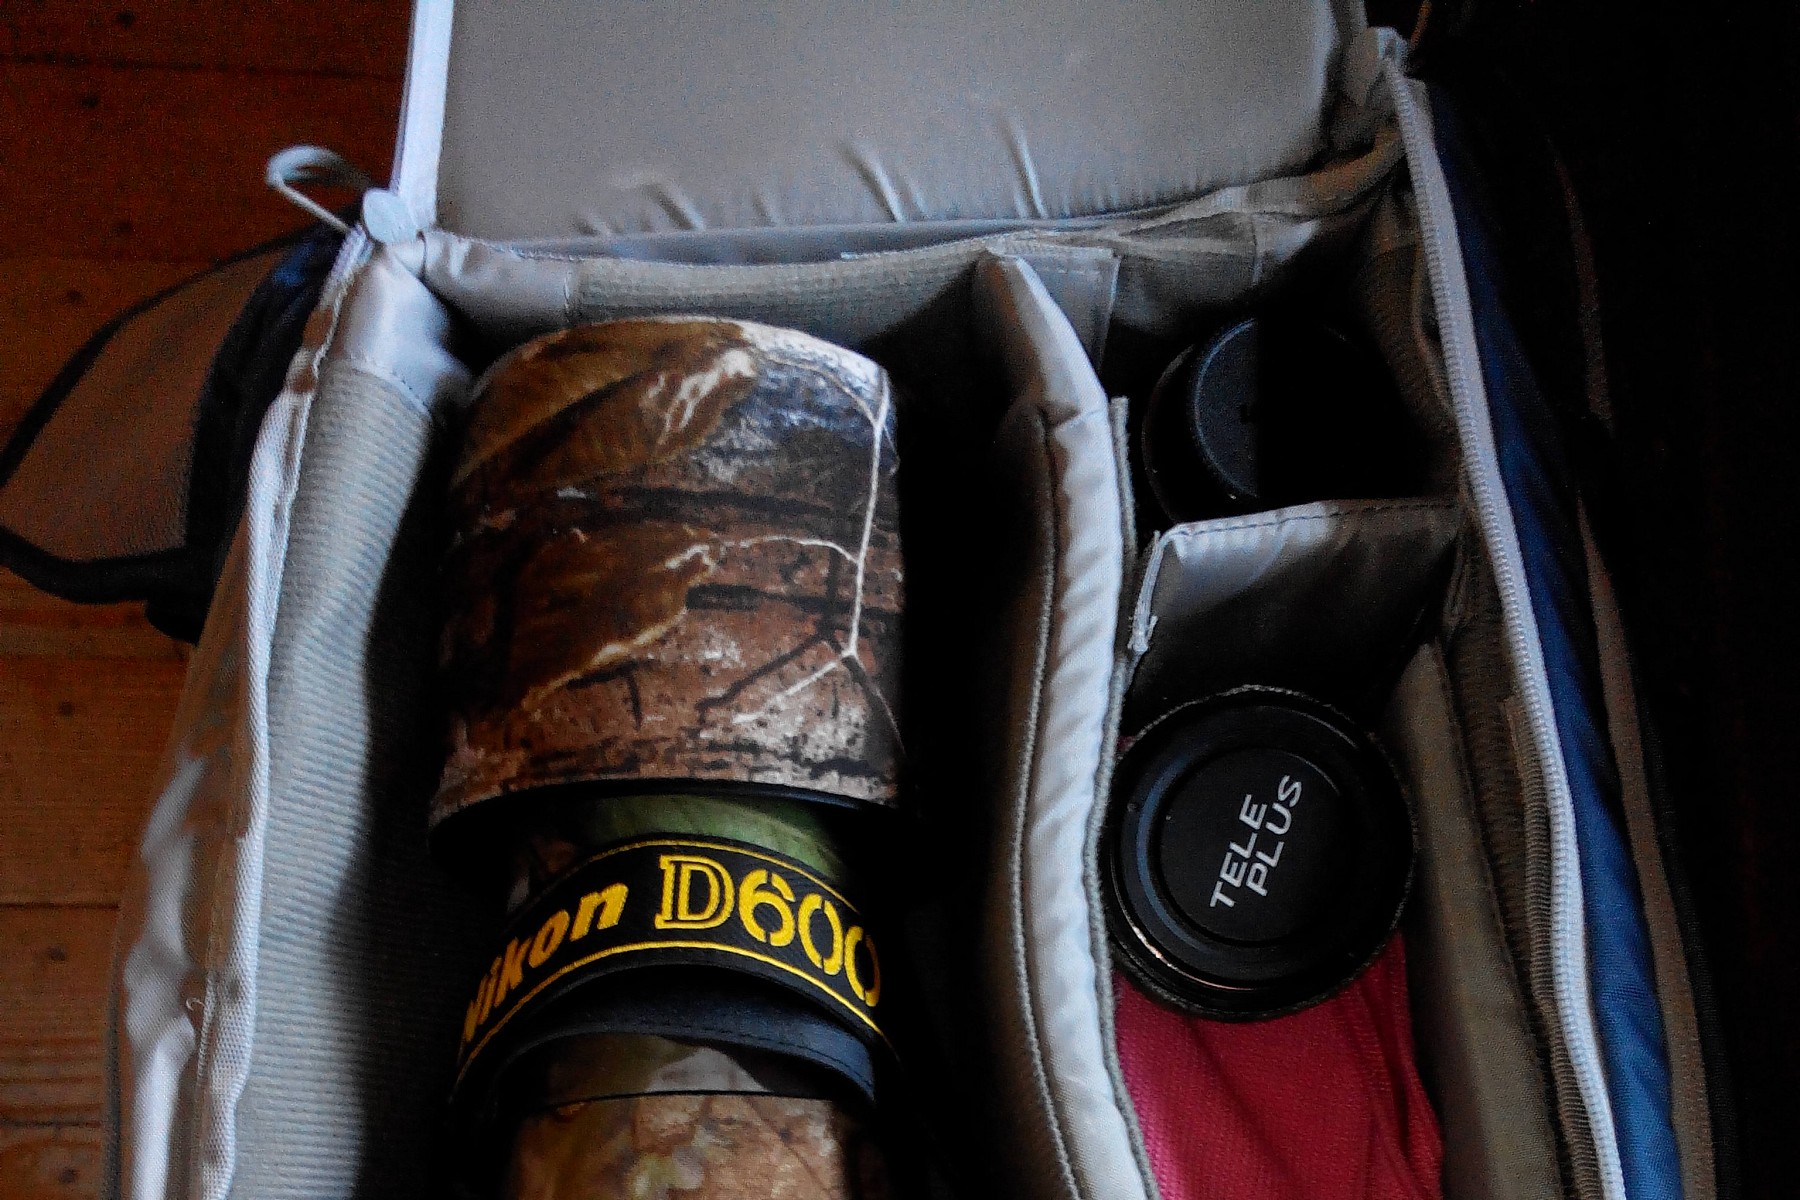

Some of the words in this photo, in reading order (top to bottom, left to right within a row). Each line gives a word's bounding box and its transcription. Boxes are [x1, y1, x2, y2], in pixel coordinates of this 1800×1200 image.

[1210, 793, 1268, 908] TELE
[1245, 774, 1302, 897] PLUS
[655, 853, 882, 1008] D600
